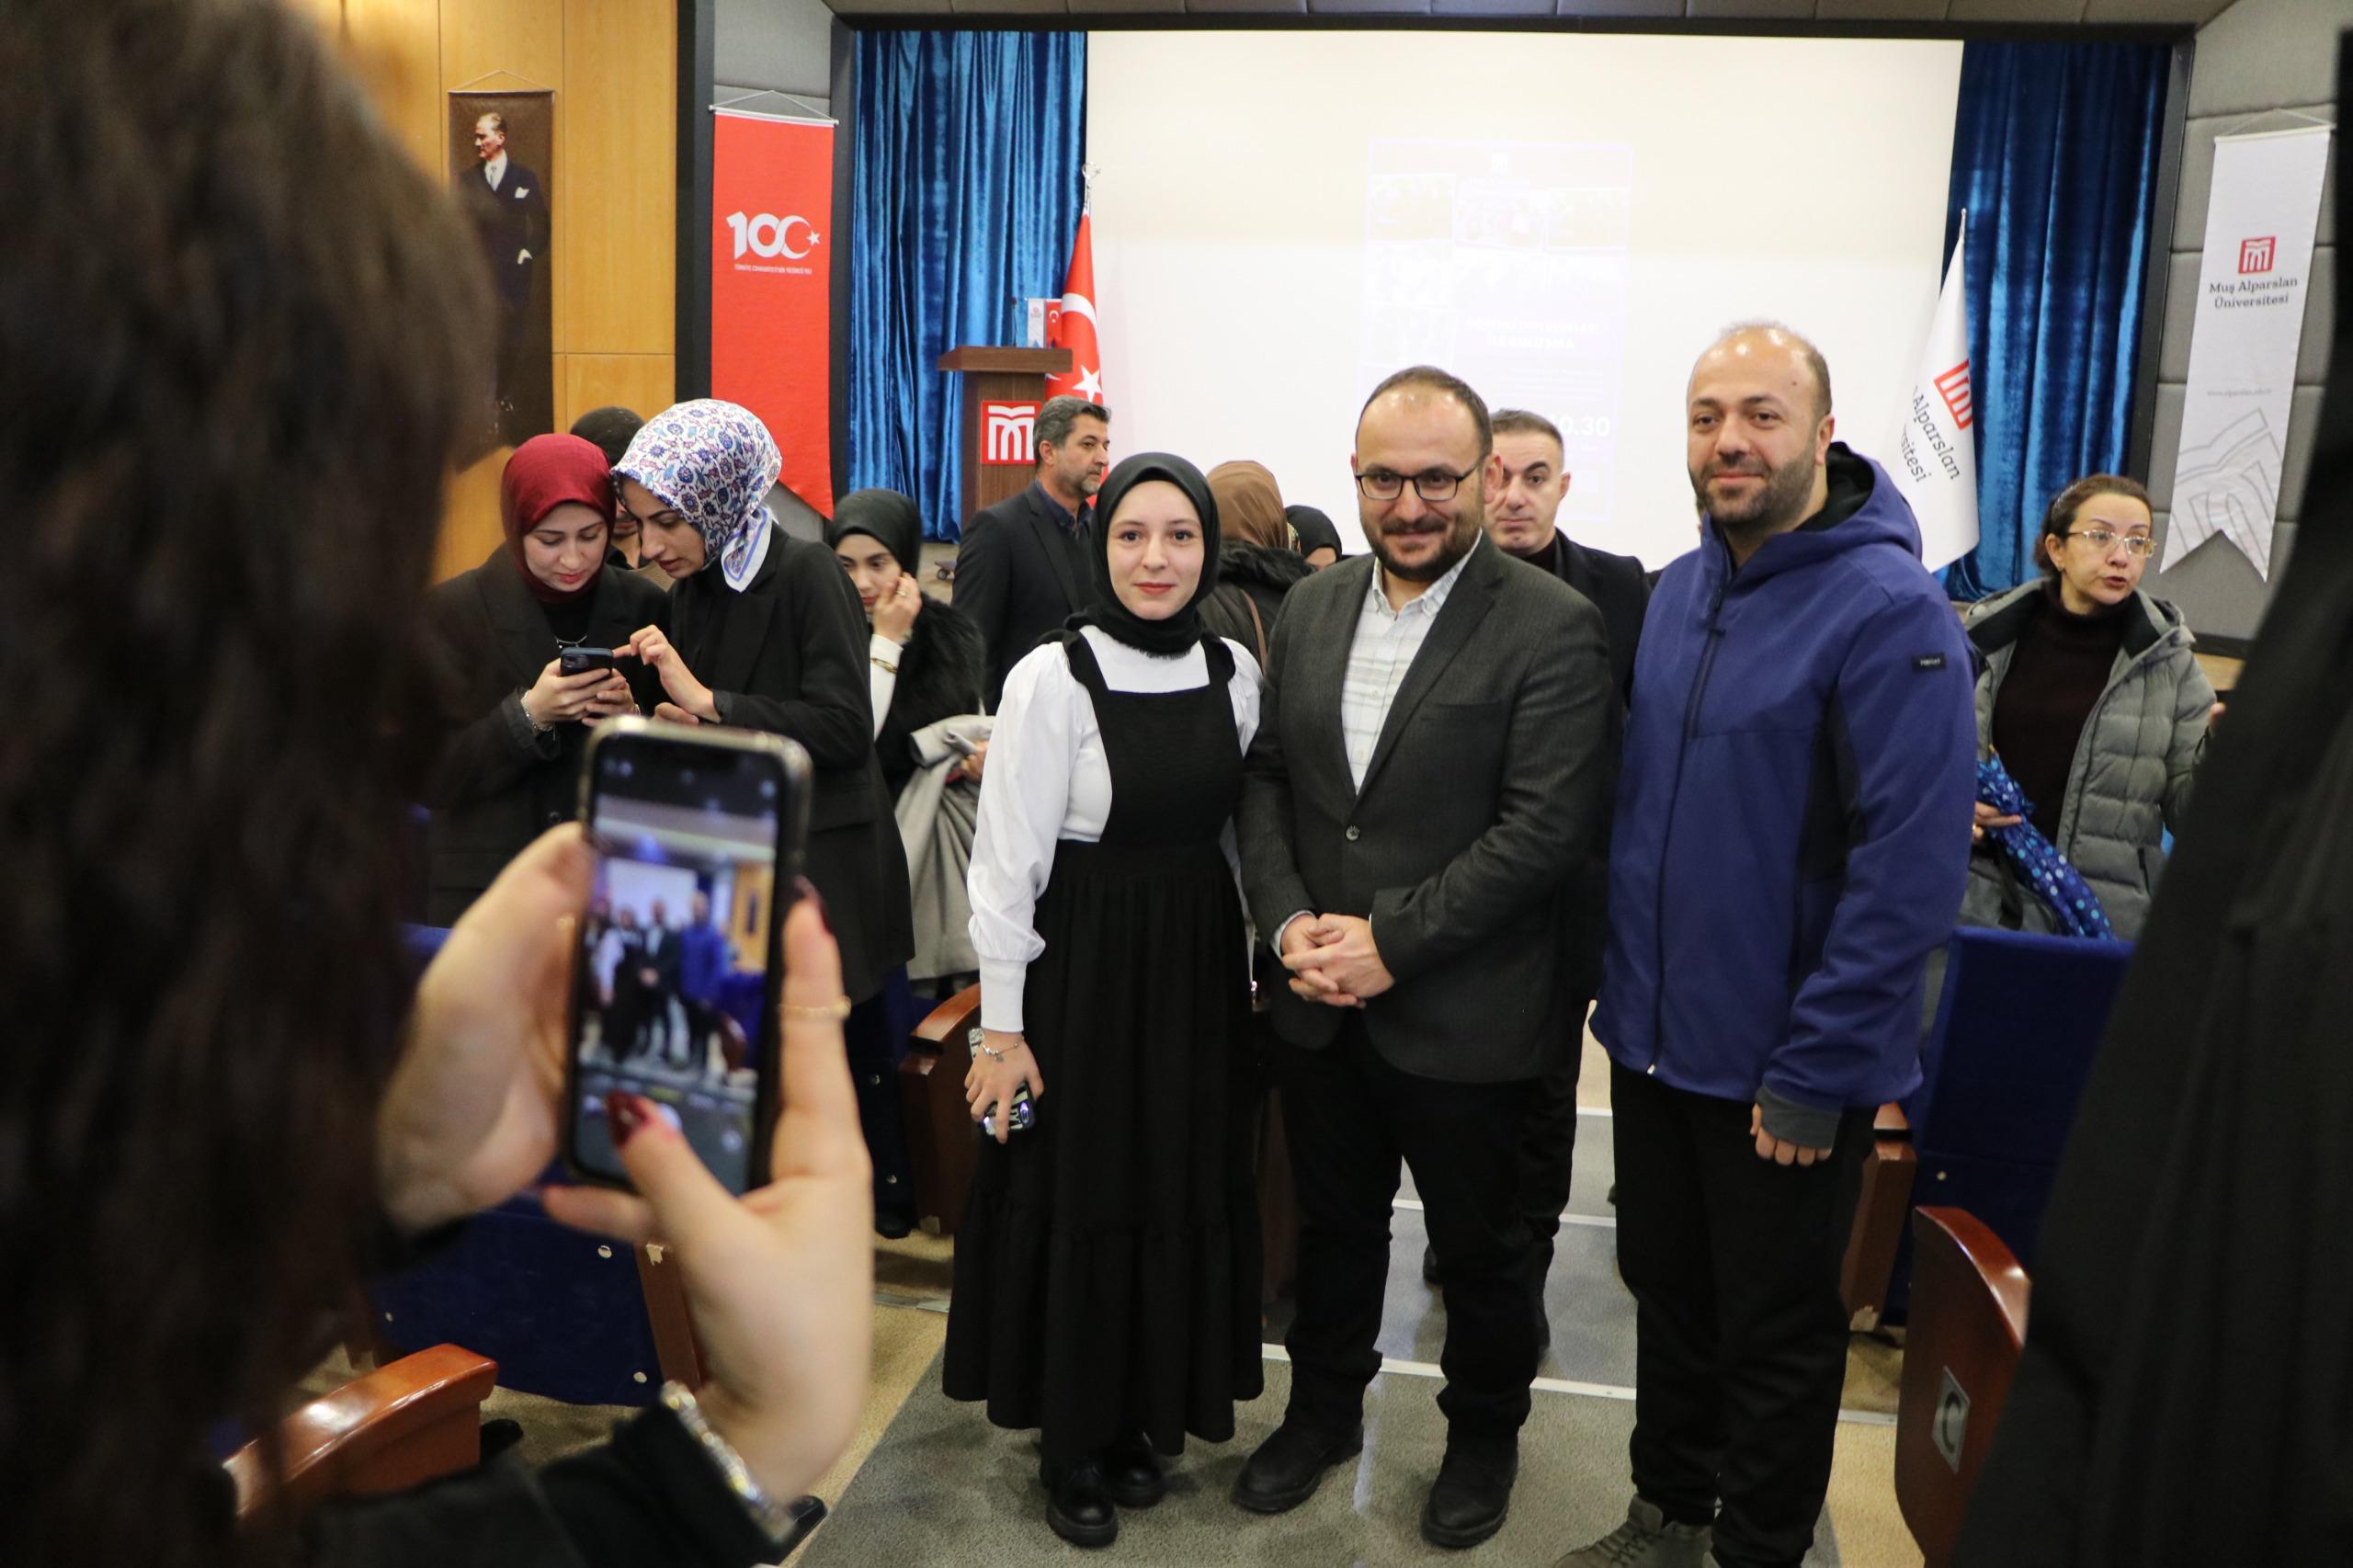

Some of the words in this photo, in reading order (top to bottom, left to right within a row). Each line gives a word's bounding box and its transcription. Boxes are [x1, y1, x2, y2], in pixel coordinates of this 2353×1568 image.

[2210, 283, 2234, 295] Muş
[2238, 277, 2298, 293] Alparslan
[2214, 293, 2289, 309] Üniversitesi
[1913, 393, 1961, 480] Alparslan
[1901, 430, 1932, 483] sitesi
